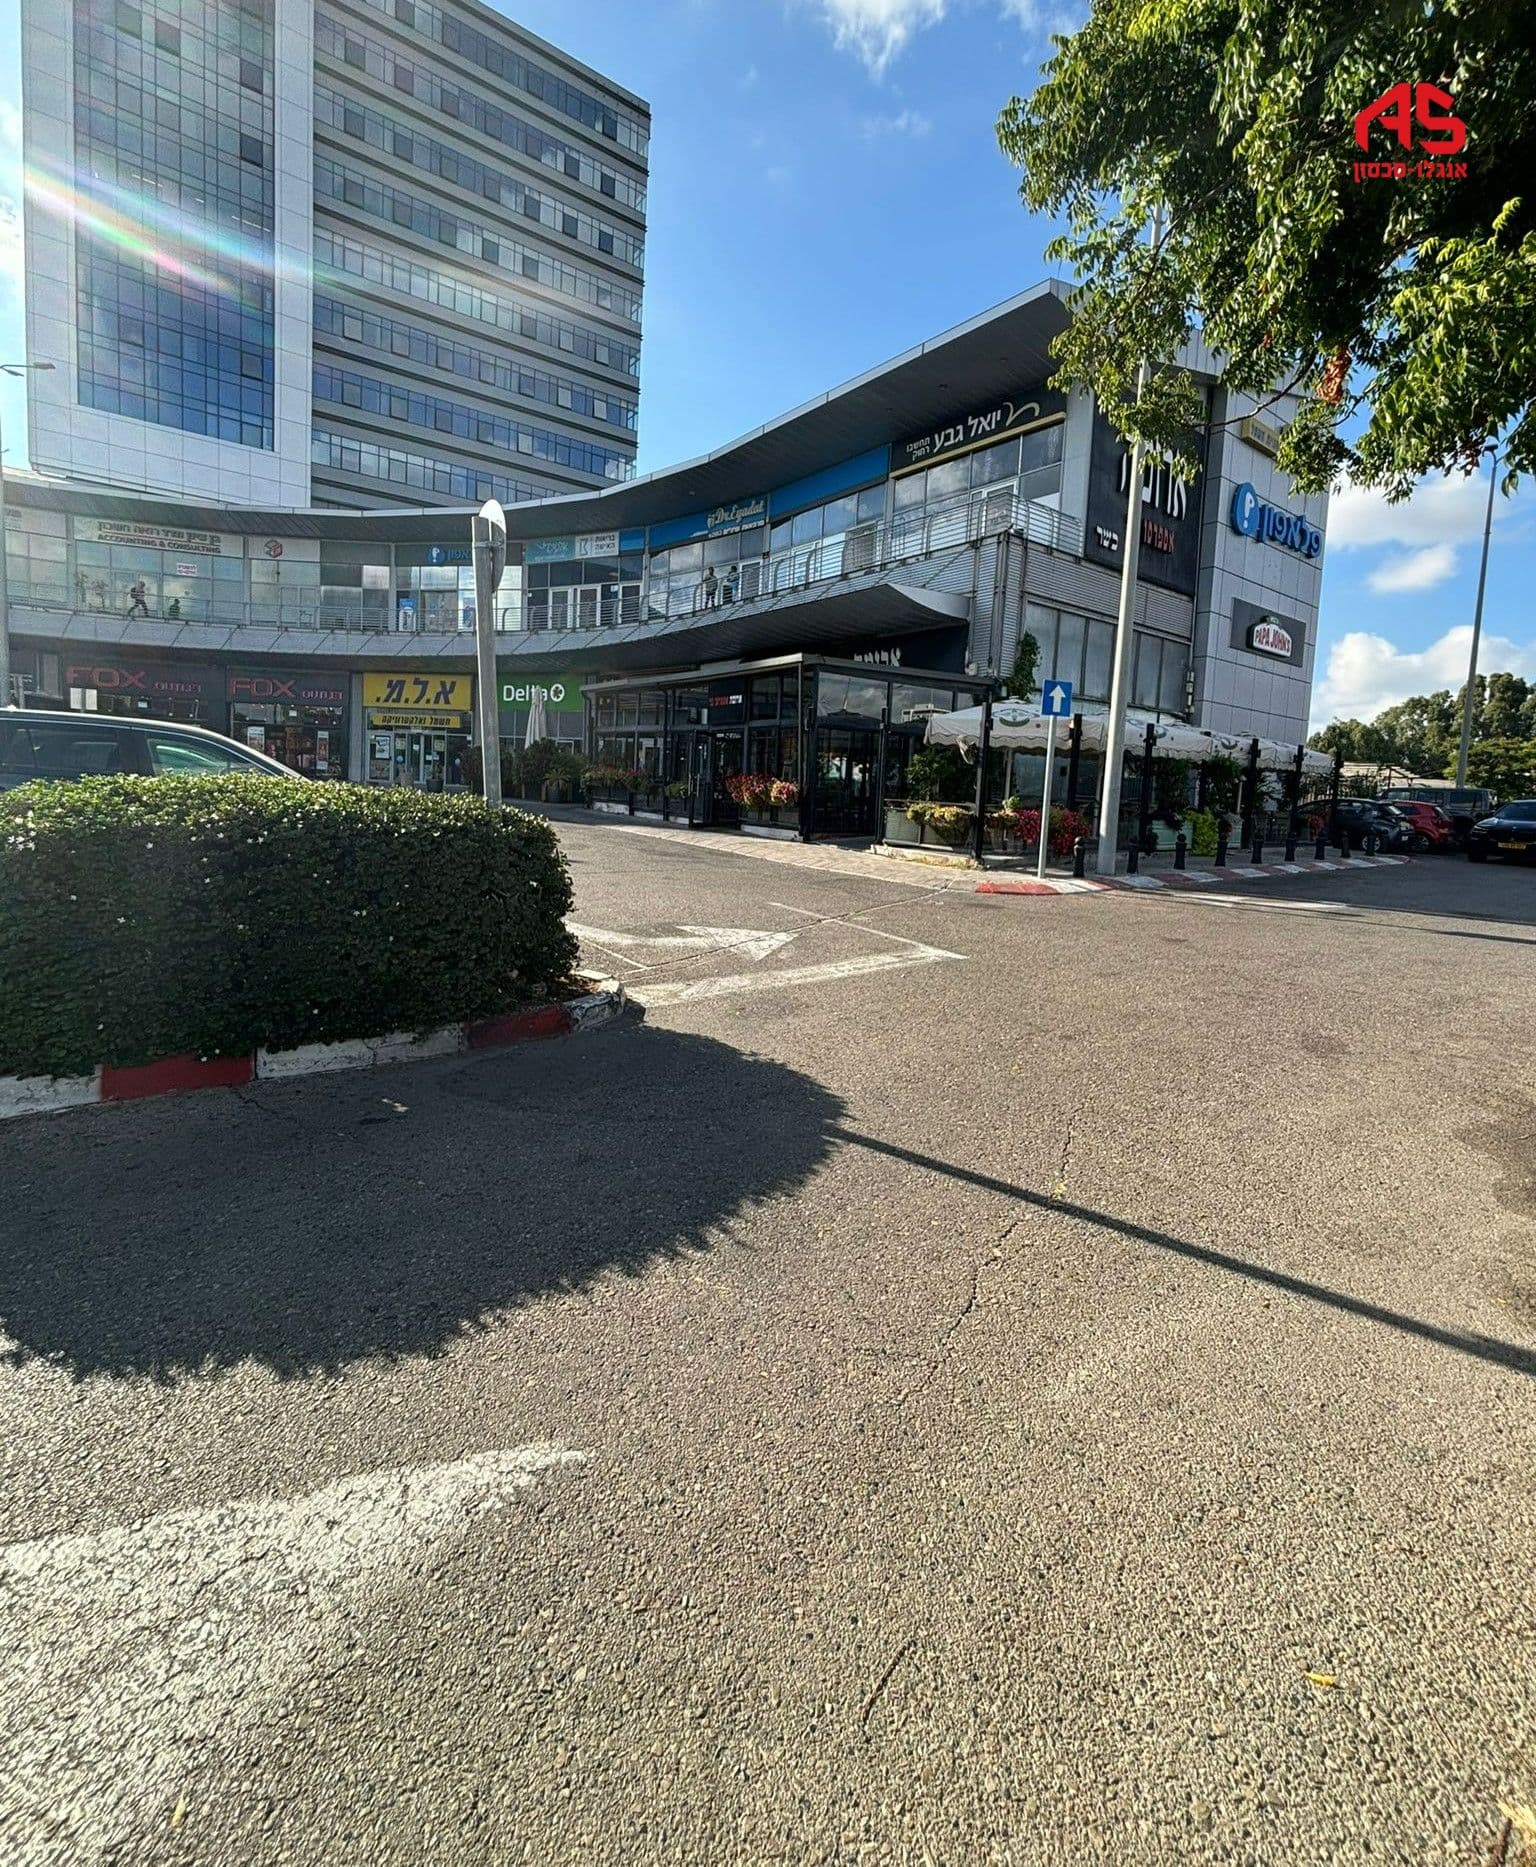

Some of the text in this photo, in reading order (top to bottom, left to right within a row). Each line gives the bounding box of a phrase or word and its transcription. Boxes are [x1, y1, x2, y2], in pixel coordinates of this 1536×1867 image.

[933, 409, 1002, 453] יואל גבע
[912, 445, 930, 462] רחוק
[1096, 525, 1119, 551] כשר
[1144, 519, 1175, 553] אספרסו
[1257, 504, 1322, 558] פלאפון
[97, 533, 157, 547] ACCOUNTING
[167, 542, 221, 554] CONSULTING
[1255, 627, 1270, 647] PAPA
[66, 666, 146, 689] FOX
[230, 678, 296, 698] FOX
[376, 677, 457, 705] א.ל.מ.
[430, 715, 451, 726] חשמל
